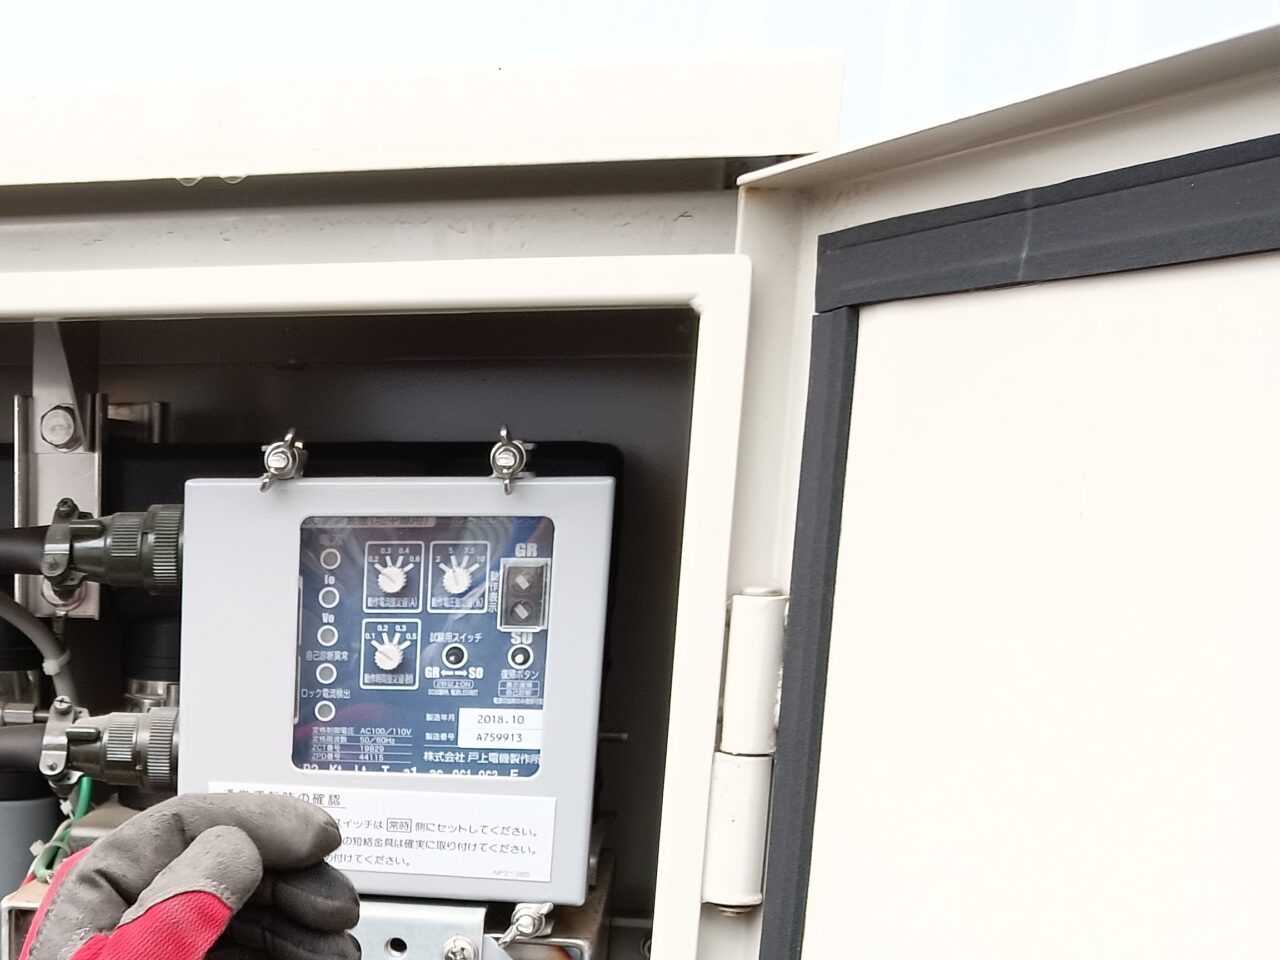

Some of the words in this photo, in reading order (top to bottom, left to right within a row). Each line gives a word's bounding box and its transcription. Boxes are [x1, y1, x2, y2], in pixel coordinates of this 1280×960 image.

[515, 543, 538, 557] GR
[510, 631, 533, 644] SO
[425, 666, 440, 679] GR
[468, 667, 484, 679] SO
[477, 714, 525, 725] 2018.10
[476, 732, 523, 742] A759913
[423, 751, 466, 763] 株式会社
[389, 820, 410, 831] 常時
